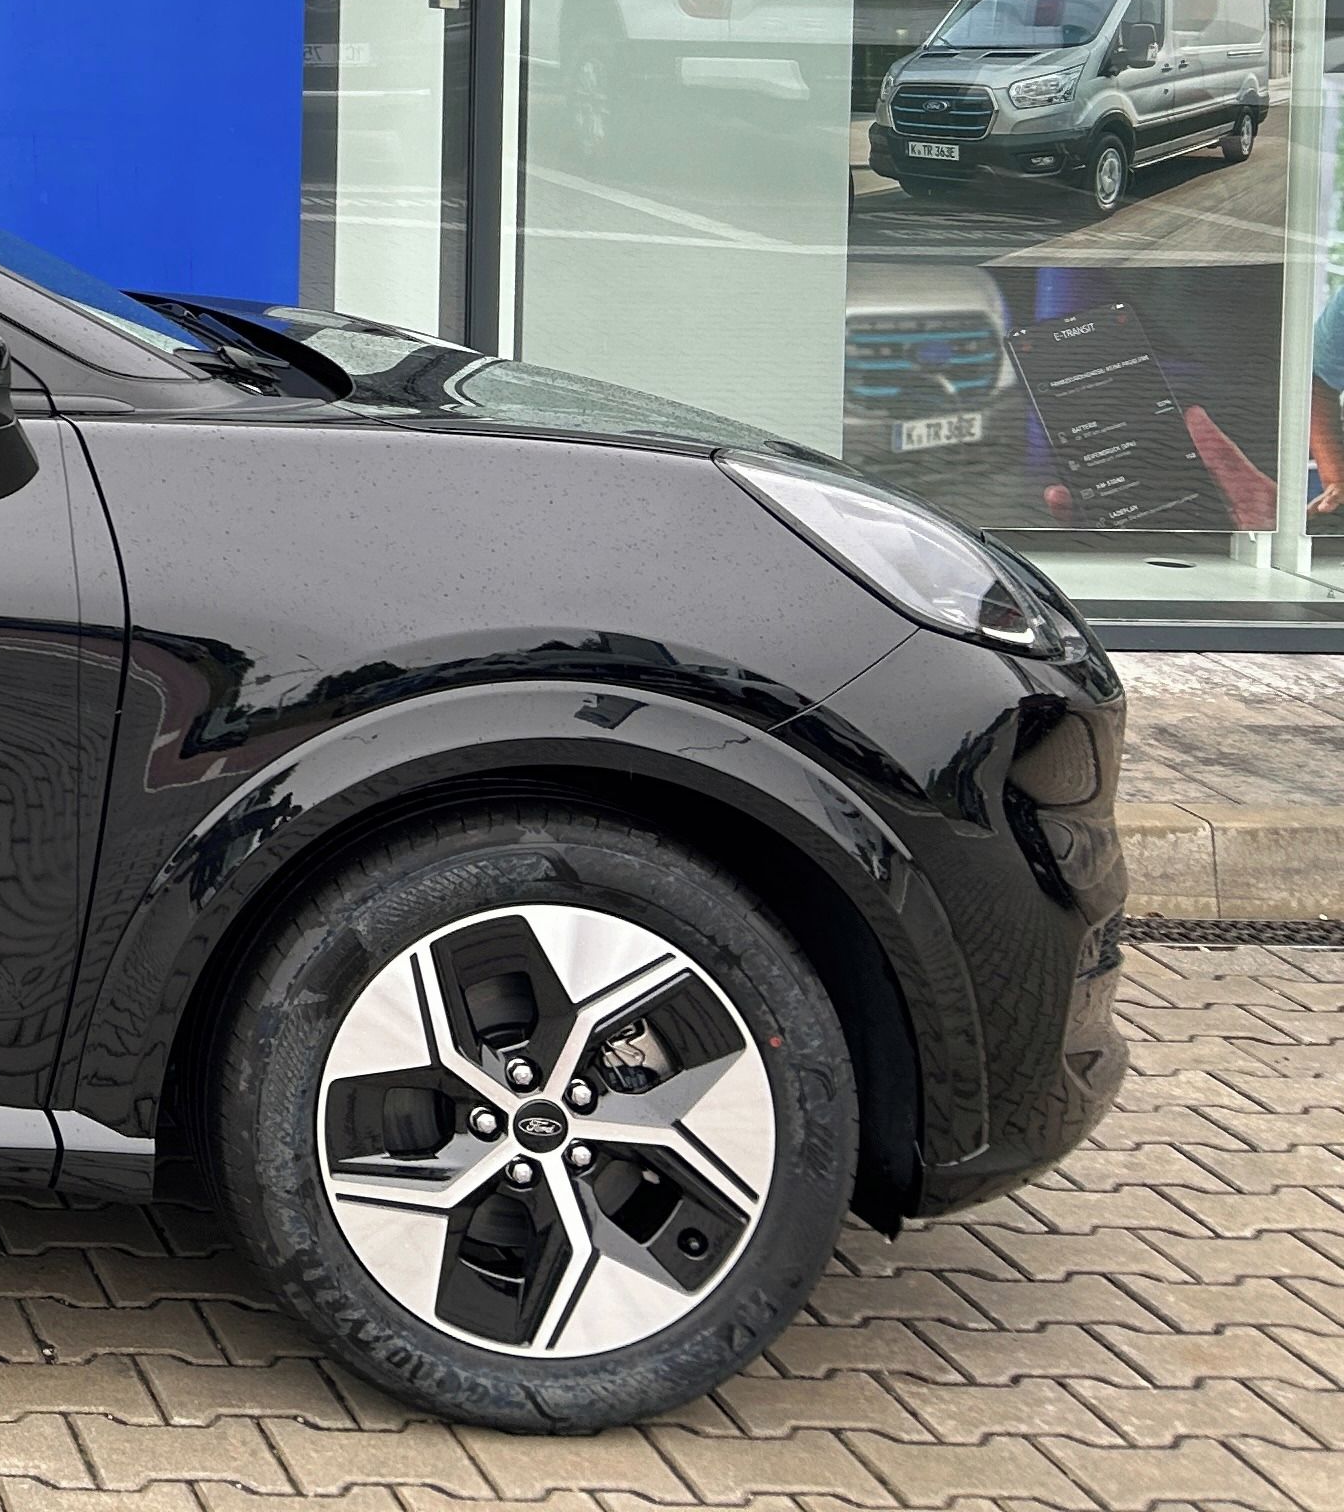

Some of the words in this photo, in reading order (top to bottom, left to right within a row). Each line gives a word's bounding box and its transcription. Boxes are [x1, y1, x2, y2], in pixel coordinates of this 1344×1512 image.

[910, 144, 916, 155] K
[922, 145, 933, 157] TR
[1053, 322, 1096, 342] E-TRANSIT
[526, 1119, 555, 1134] Ford
